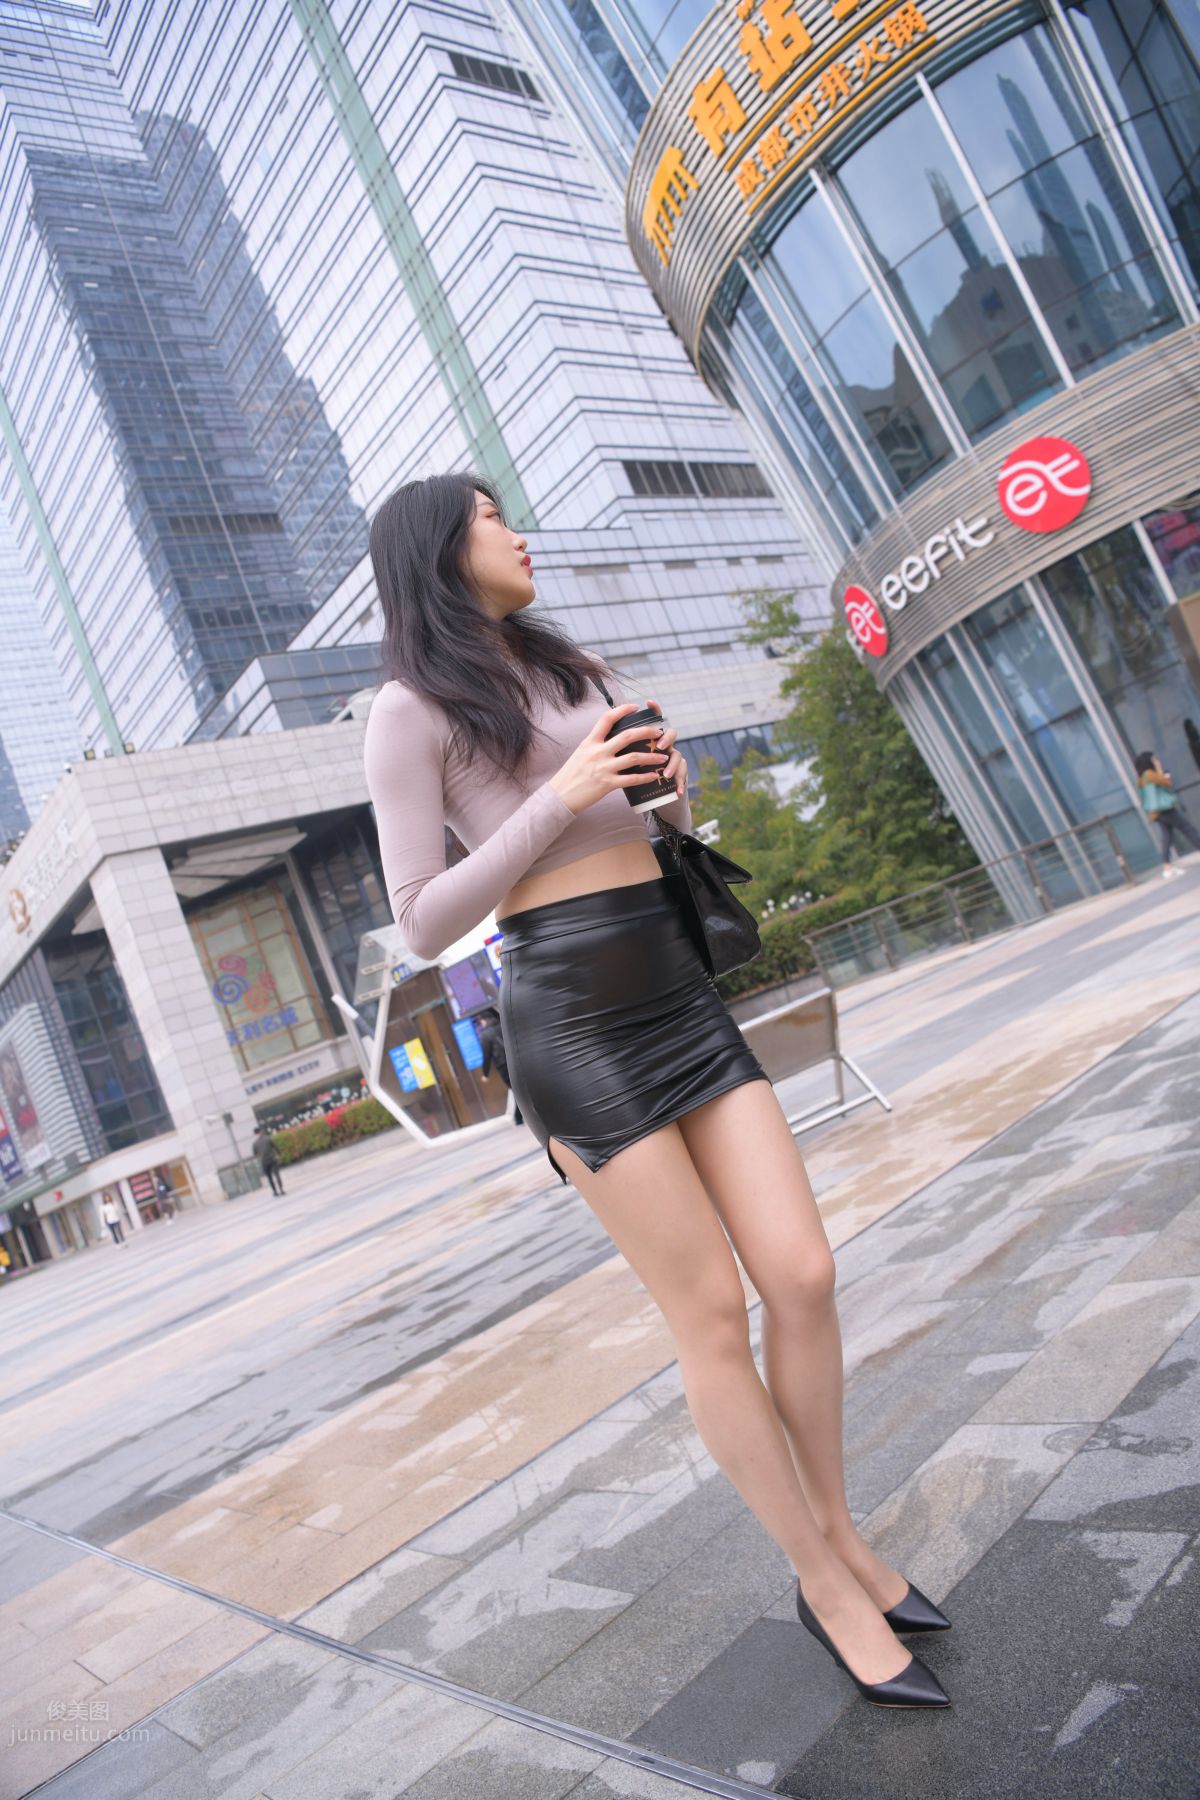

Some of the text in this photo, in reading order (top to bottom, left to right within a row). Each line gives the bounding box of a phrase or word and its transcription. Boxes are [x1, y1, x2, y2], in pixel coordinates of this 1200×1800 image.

[688, 0, 860, 158] 有拈
[735, 0, 928, 203] 成都市井火锅
[881, 517, 995, 611] eefit
